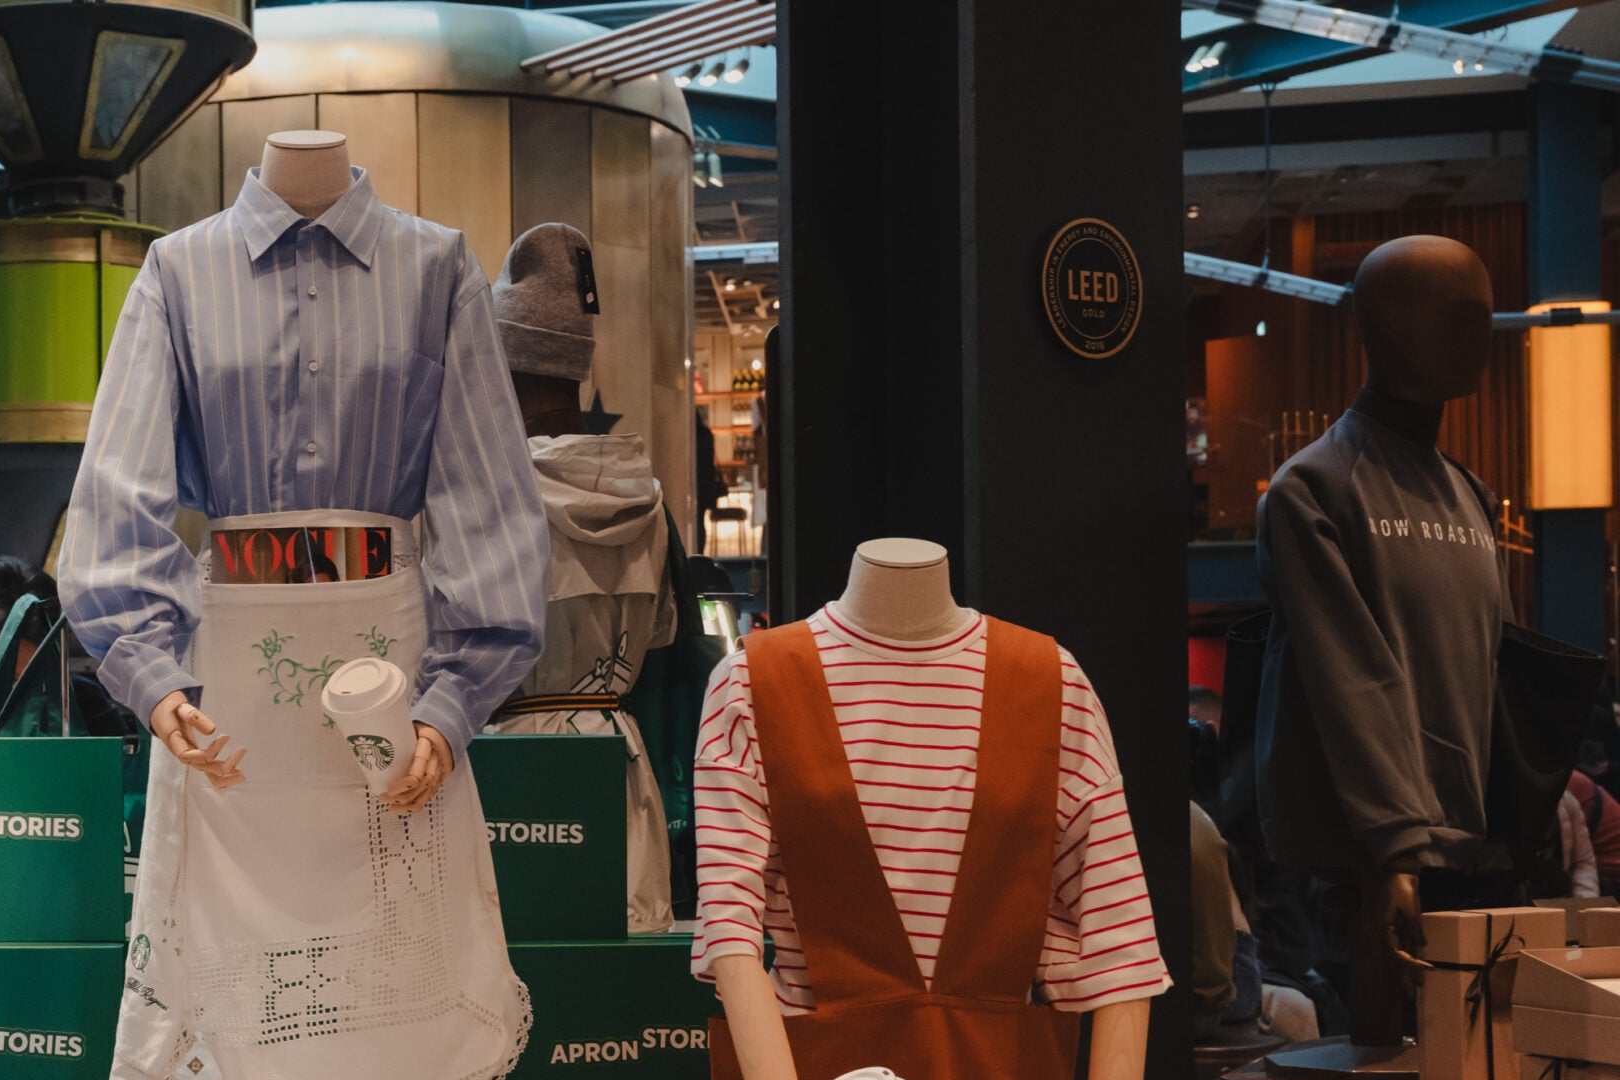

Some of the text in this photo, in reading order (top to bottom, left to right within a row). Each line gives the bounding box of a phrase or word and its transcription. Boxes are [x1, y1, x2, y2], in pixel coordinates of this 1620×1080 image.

[1067, 269, 1119, 303] LEED
[1082, 308, 1106, 319] GOLD
[484, 822, 584, 844] STORIES
[550, 1028, 710, 1064] APRON STOR
